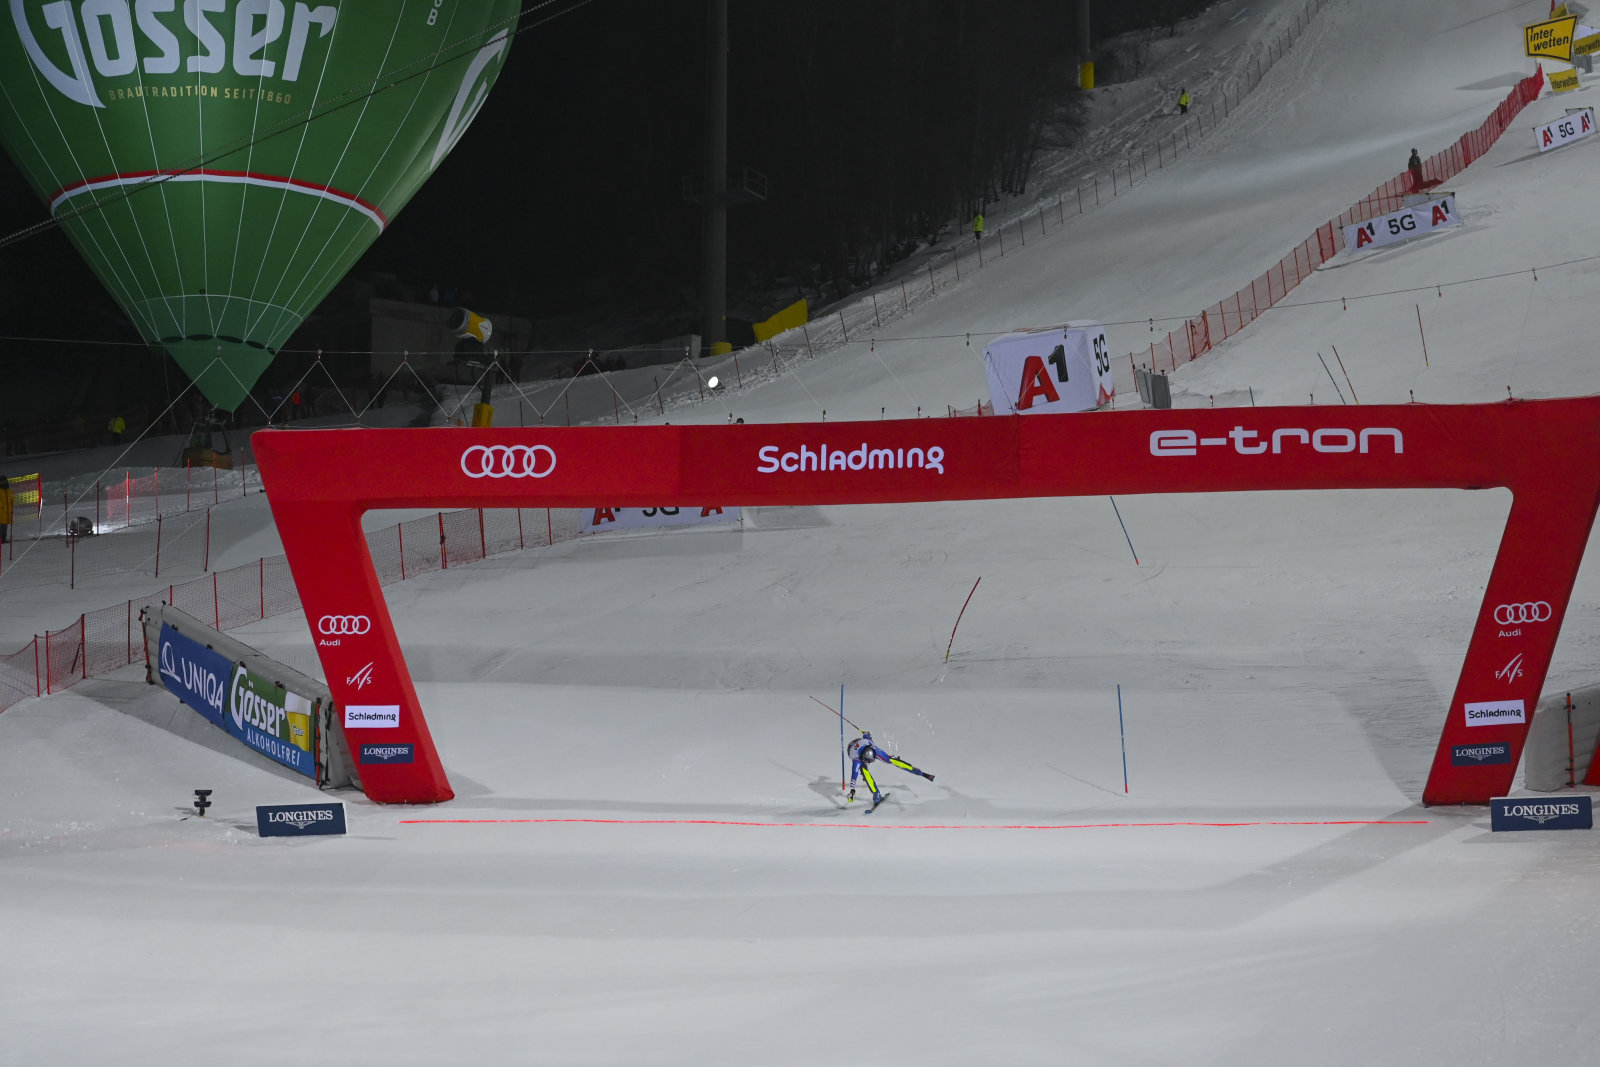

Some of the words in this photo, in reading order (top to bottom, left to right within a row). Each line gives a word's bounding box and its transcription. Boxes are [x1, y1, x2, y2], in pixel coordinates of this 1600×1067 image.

[1534, 36, 1569, 52] wetten
[108, 85, 218, 100] BRAUTRADITION
[224, 88, 255, 99] SEIT
[260, 91, 292, 105] 1860
[1542, 126, 1553, 147] A1
[1558, 122, 1575, 138] 5G
[1581, 112, 1590, 133] A1
[1357, 222, 1375, 248] A1
[1388, 214, 1416, 235] 5G
[1431, 200, 1449, 226] A1
[1093, 334, 1110, 377] 5G
[1017, 344, 1069, 411] A1
[1150, 426, 1403, 456] e-tron
[757, 443, 944, 474] Schladming
[319, 639, 341, 647] Audi
[1498, 629, 1521, 637] Audi
[181, 657, 224, 714] UNIQA
[230, 666, 285, 738] Gösser
[348, 712, 396, 722] Schladming
[1468, 709, 1522, 719] Schladming
[246, 727, 300, 767] ALKOHOLFREI
[364, 747, 409, 755] LONGINES
[1455, 747, 1505, 757] LONGINES
[268, 809, 334, 823] LONGINES
[1503, 803, 1580, 817] LONGINES
